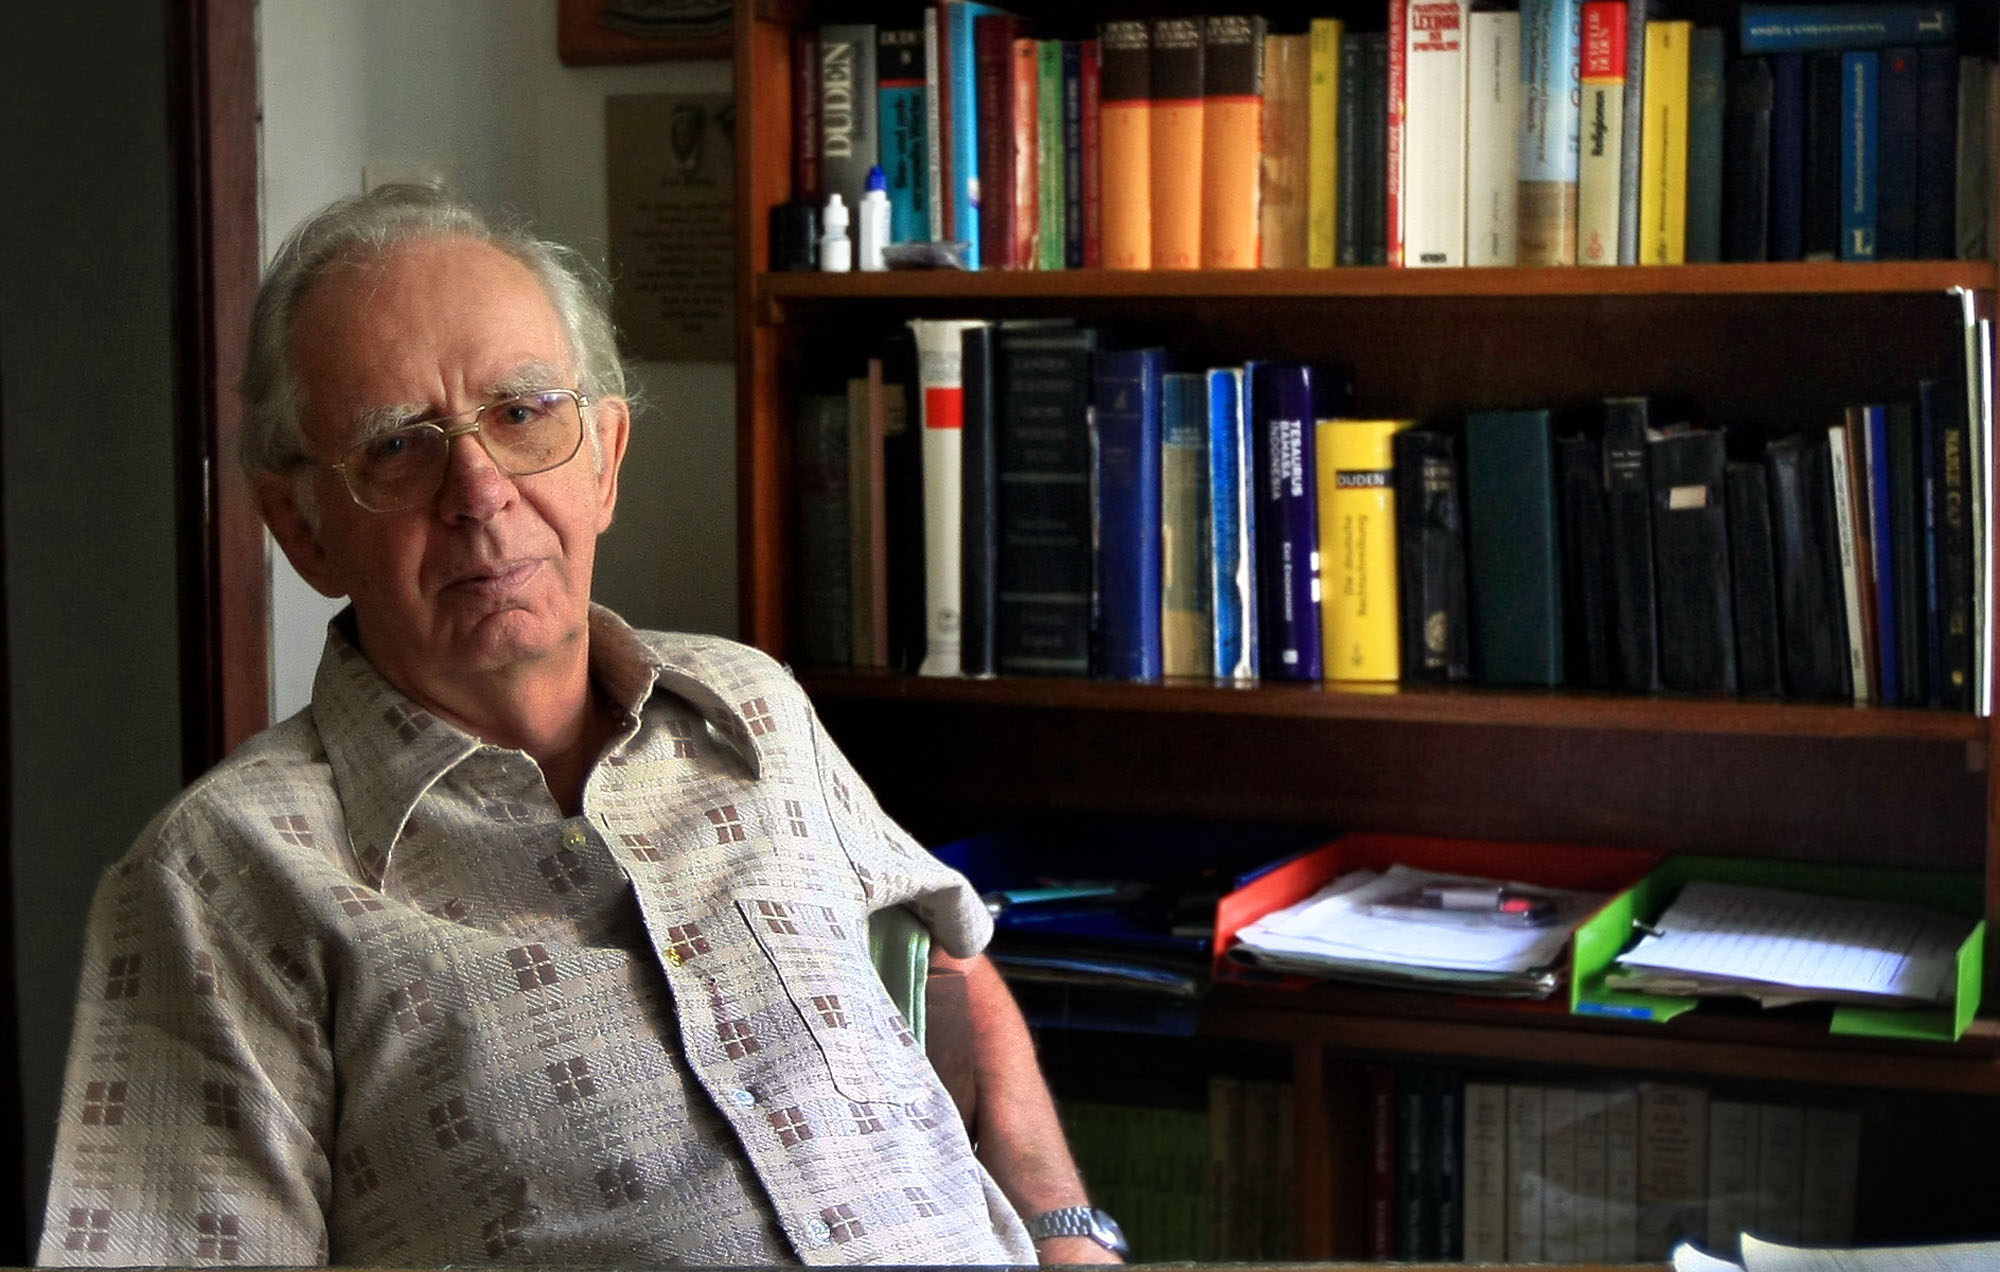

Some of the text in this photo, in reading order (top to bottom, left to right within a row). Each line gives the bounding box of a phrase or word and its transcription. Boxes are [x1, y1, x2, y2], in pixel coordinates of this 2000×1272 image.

[1413, 13, 1460, 29] LEXIKON
[823, 43, 852, 159] DUDEN
[1590, 89, 1607, 157] Religionen
[1280, 420, 1292, 478] BAHASA
[1290, 419, 1304, 497] TESAURUS
[1336, 472, 1386, 488] DUDEN
[1343, 515, 1354, 571] deutsche
[1356, 514, 1369, 617] Rechtschreibung
